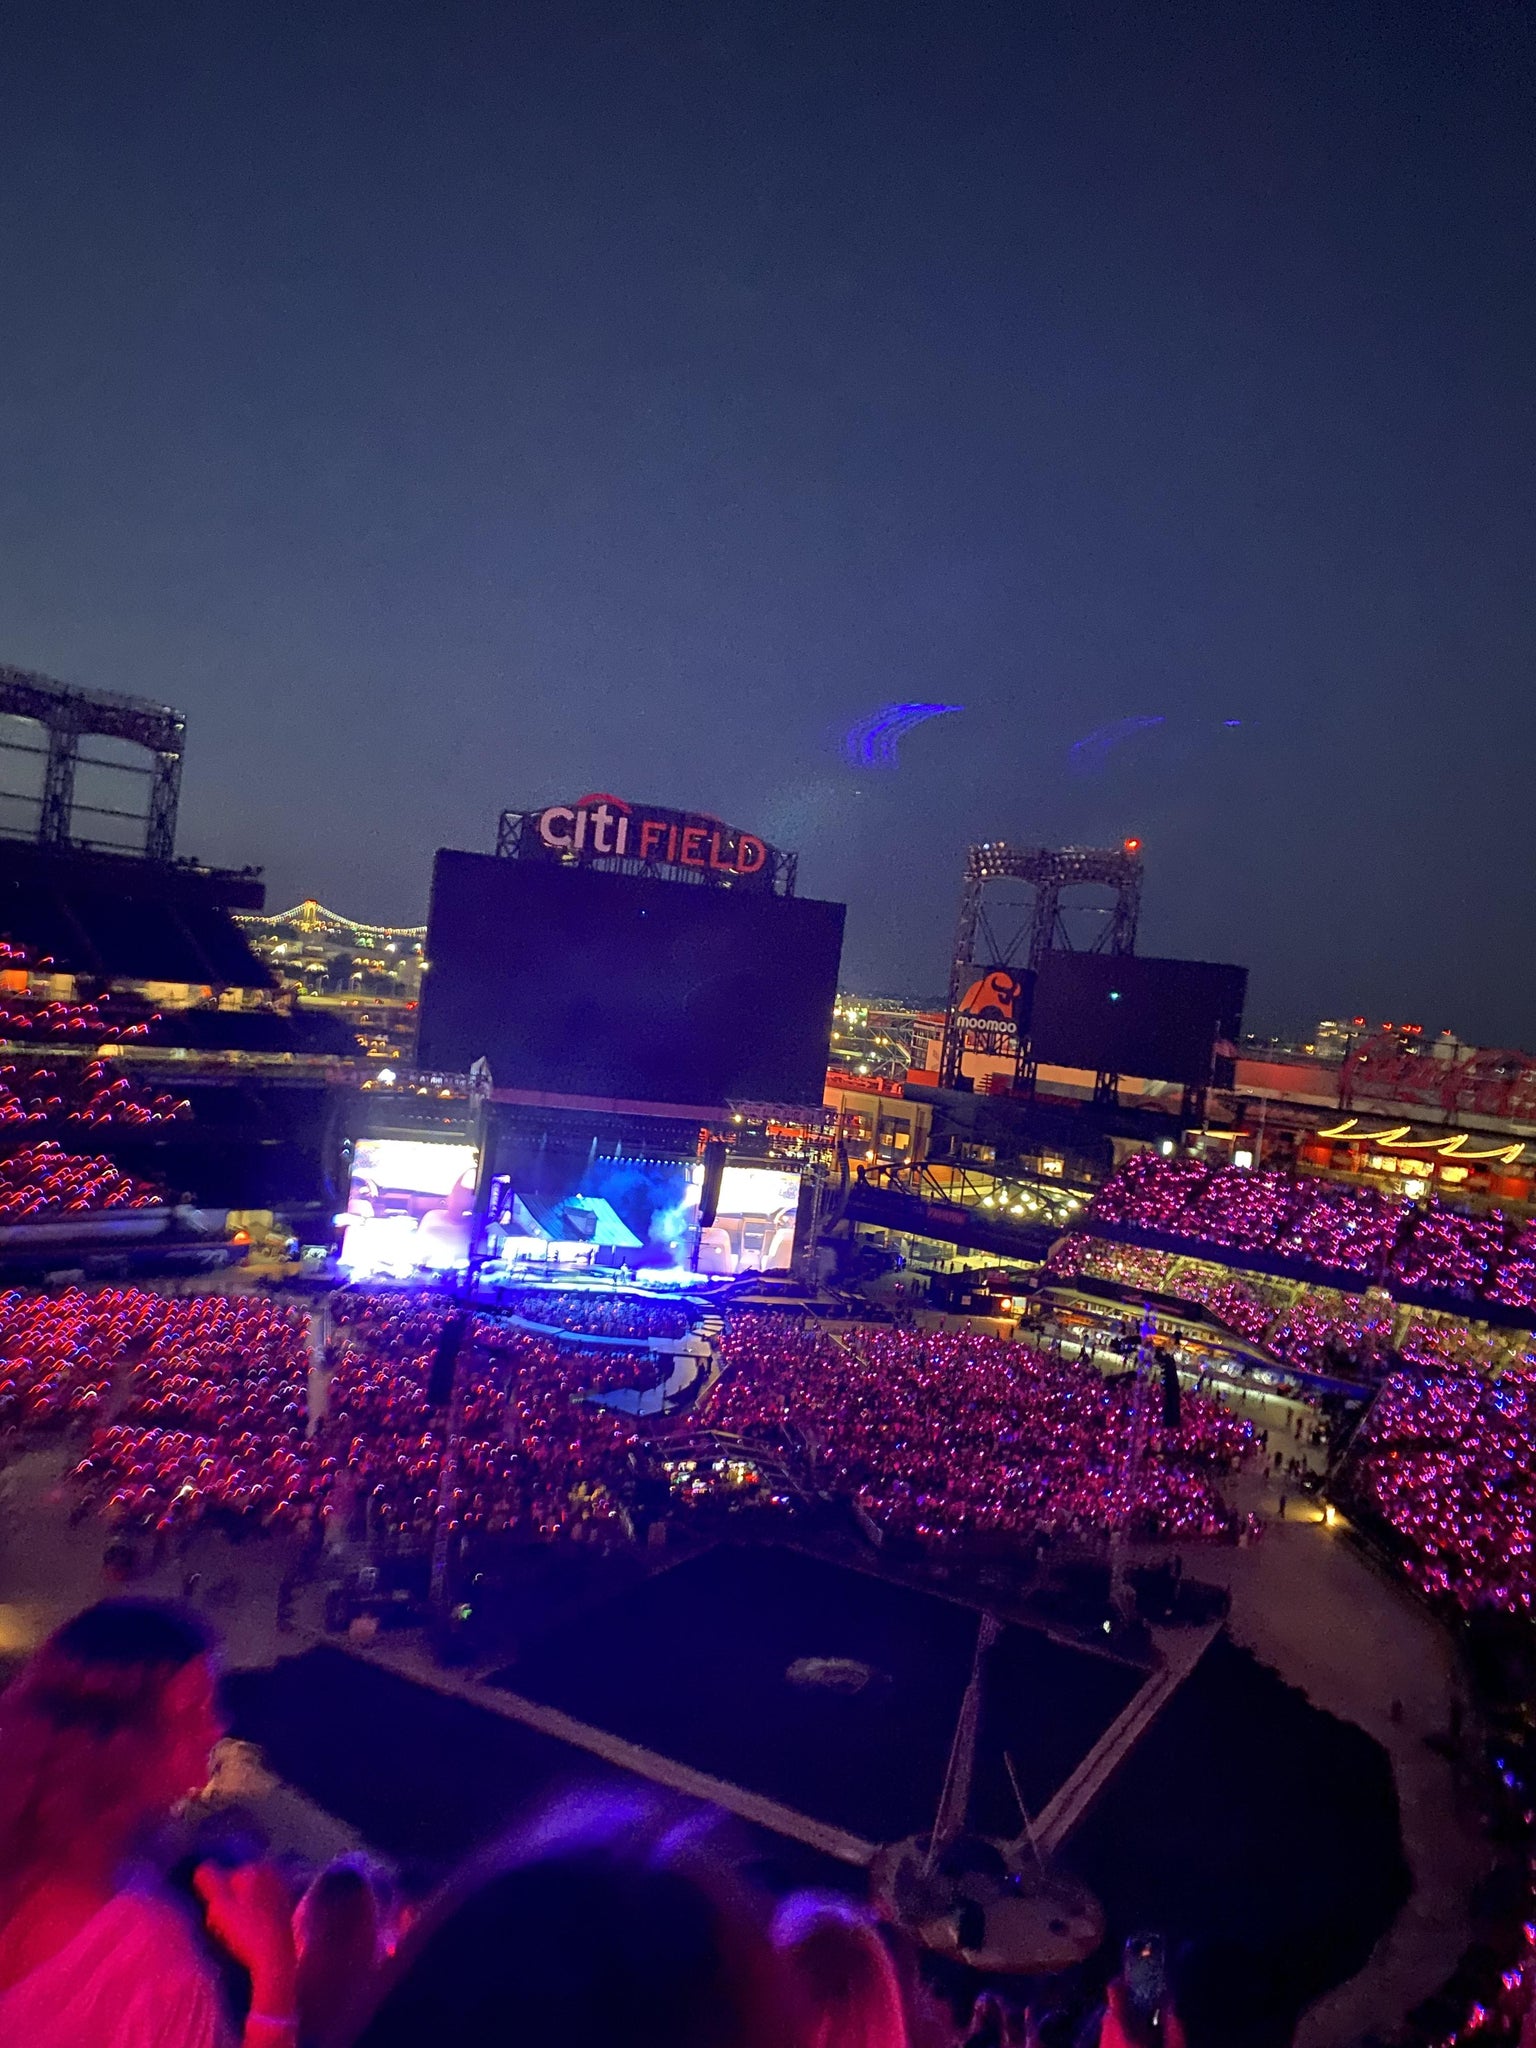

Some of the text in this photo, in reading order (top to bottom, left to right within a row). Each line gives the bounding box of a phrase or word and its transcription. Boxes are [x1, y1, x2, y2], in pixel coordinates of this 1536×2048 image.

[539, 804, 767, 873] citi FIELD
[956, 1015, 1017, 1034] moomoo
